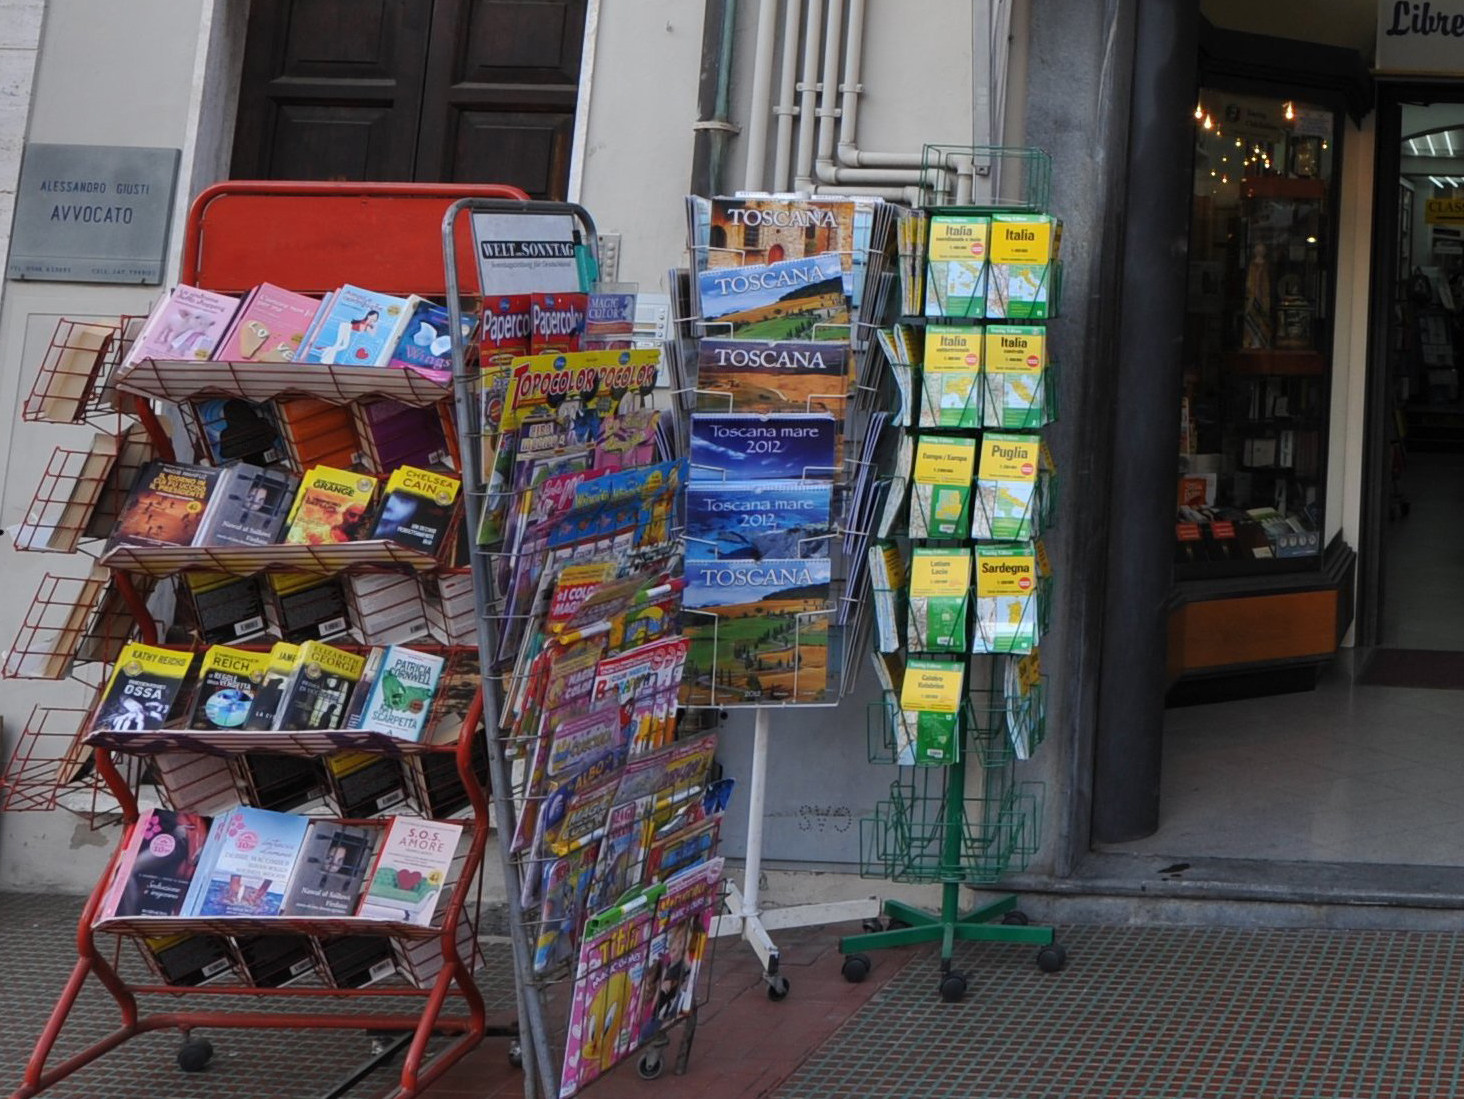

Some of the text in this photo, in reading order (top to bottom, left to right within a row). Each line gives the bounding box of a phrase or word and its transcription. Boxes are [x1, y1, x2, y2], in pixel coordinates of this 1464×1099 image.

[40, 180, 150, 196] ALESSANDRO GIUSTI
[50, 204, 133, 225] AVVOCATO
[727, 207, 838, 228] TOSCANA
[945, 225, 973, 237] Italia
[1005, 228, 1035, 242] Italia
[482, 241, 575, 258] WELT SONNTAG
[715, 264, 826, 296] TOSCANA
[482, 309, 531, 346] Paperco
[940, 335, 967, 347] Italia
[1001, 336, 1028, 349] Italia
[406, 344, 453, 369] Wings
[715, 348, 827, 370] TOSCANA
[599, 364, 656, 389] POCOLOR
[709, 424, 820, 439] Toscana mare
[746, 440, 782, 453] 2012
[991, 444, 1029, 462] Puglia
[402, 477, 438, 495] CAIN
[406, 470, 454, 490] CHELSEA
[703, 497, 815, 513] Toscana mare
[740, 513, 777, 527] 2012
[981, 562, 1030, 576] Sardegna
[701, 568, 814, 588] TOSCANA
[131, 649, 157, 663] KATHY
[213, 656, 250, 672] REICH
[311, 652, 357, 674] GEORGE
[394, 658, 432, 674] PATRICIA
[123, 684, 163, 700] OSSA
[371, 710, 418, 730] SCARPETTA
[408, 827, 441, 842] S.O.S.
[400, 837, 445, 853] AMORE
